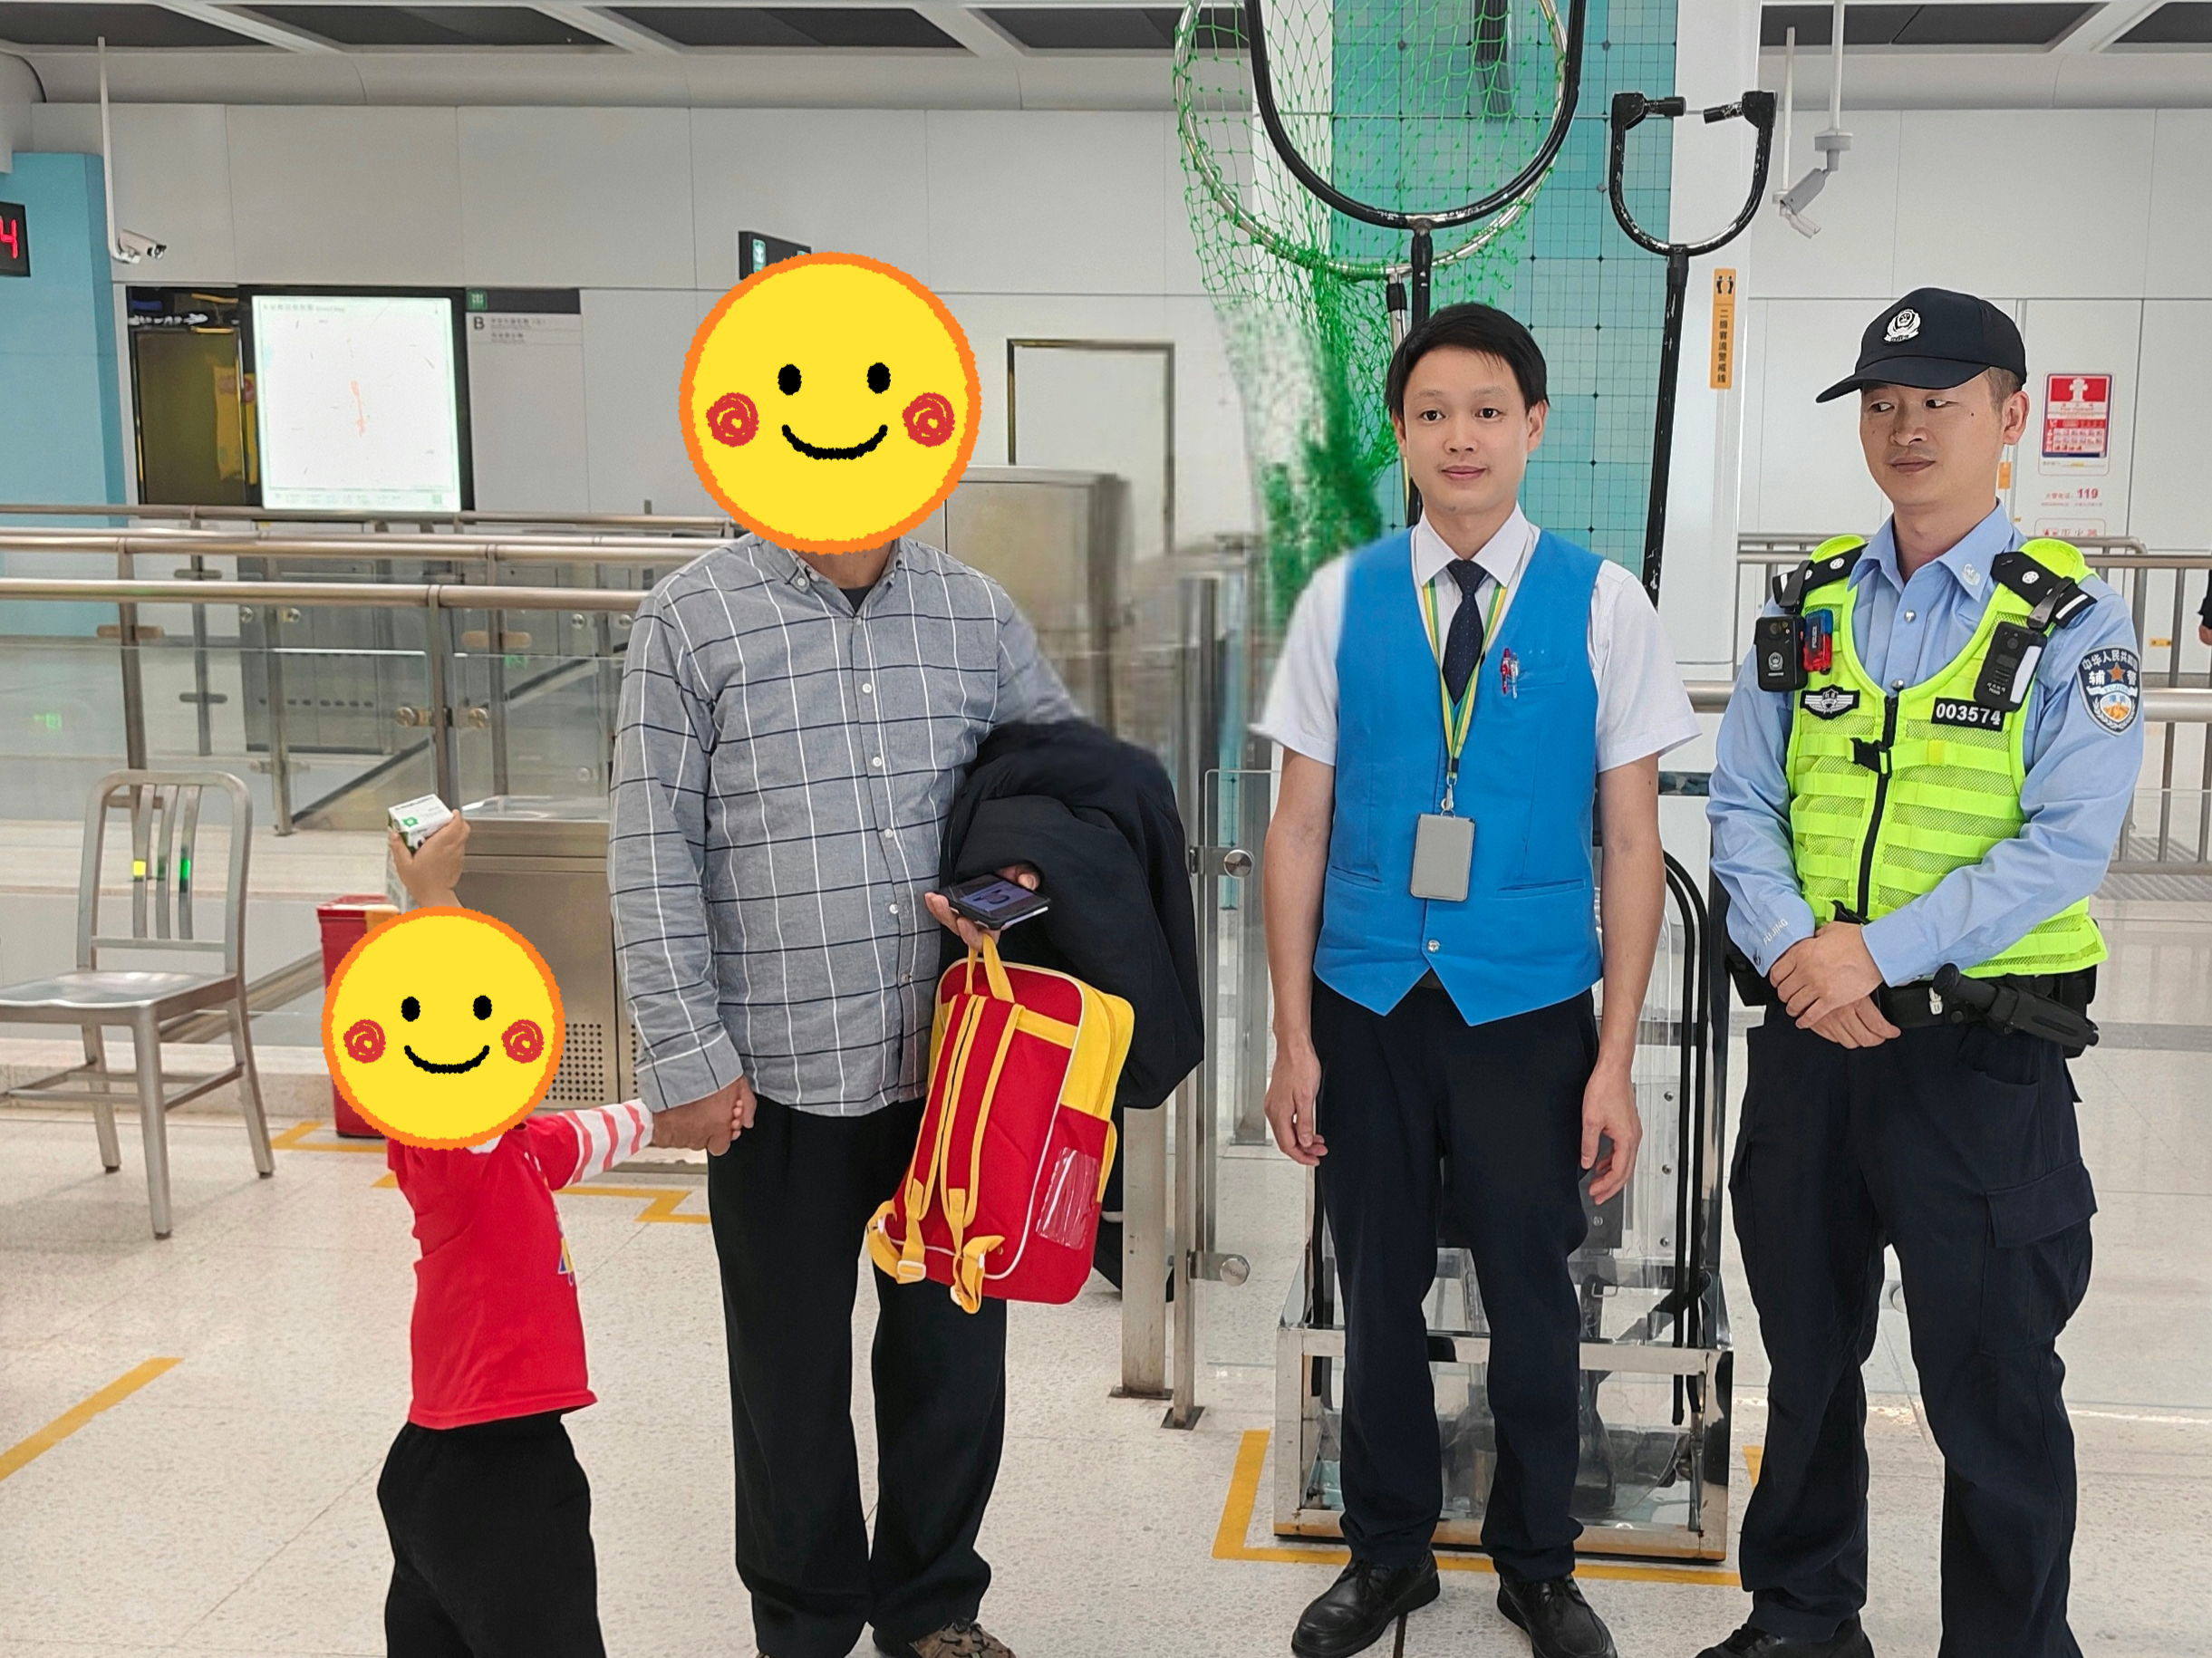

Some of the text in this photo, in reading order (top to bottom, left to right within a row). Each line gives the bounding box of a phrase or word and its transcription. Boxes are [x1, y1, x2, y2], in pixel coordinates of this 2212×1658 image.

[473, 315, 485, 330] B
[2077, 488, 2099, 499] 119
[2082, 649, 2139, 672] 中华人民共和国
[1936, 703, 2001, 726] 003574
